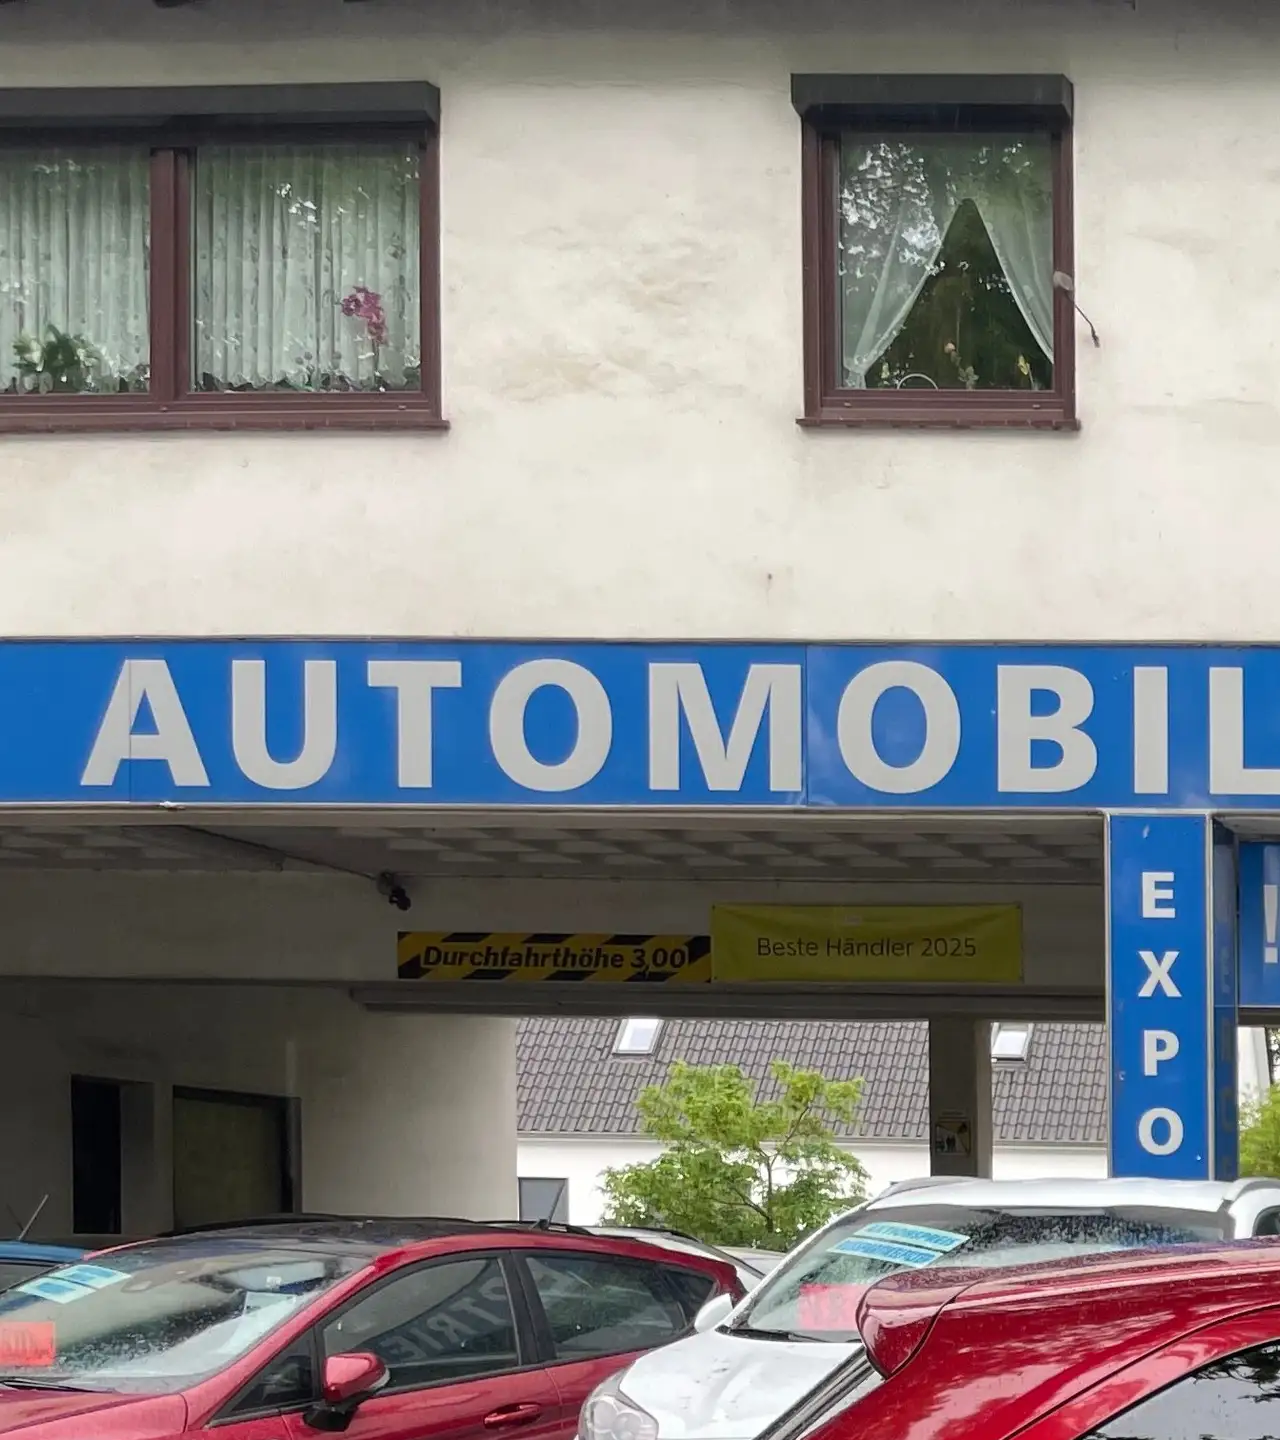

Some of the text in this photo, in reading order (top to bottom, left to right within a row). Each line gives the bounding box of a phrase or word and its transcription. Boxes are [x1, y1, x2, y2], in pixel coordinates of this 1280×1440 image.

[422, 945, 687, 976] Durchfahrthöhe 3,00
[757, 937, 977, 958] Beste Händler 2025
[1138, 871, 1184, 1156] EXPO
